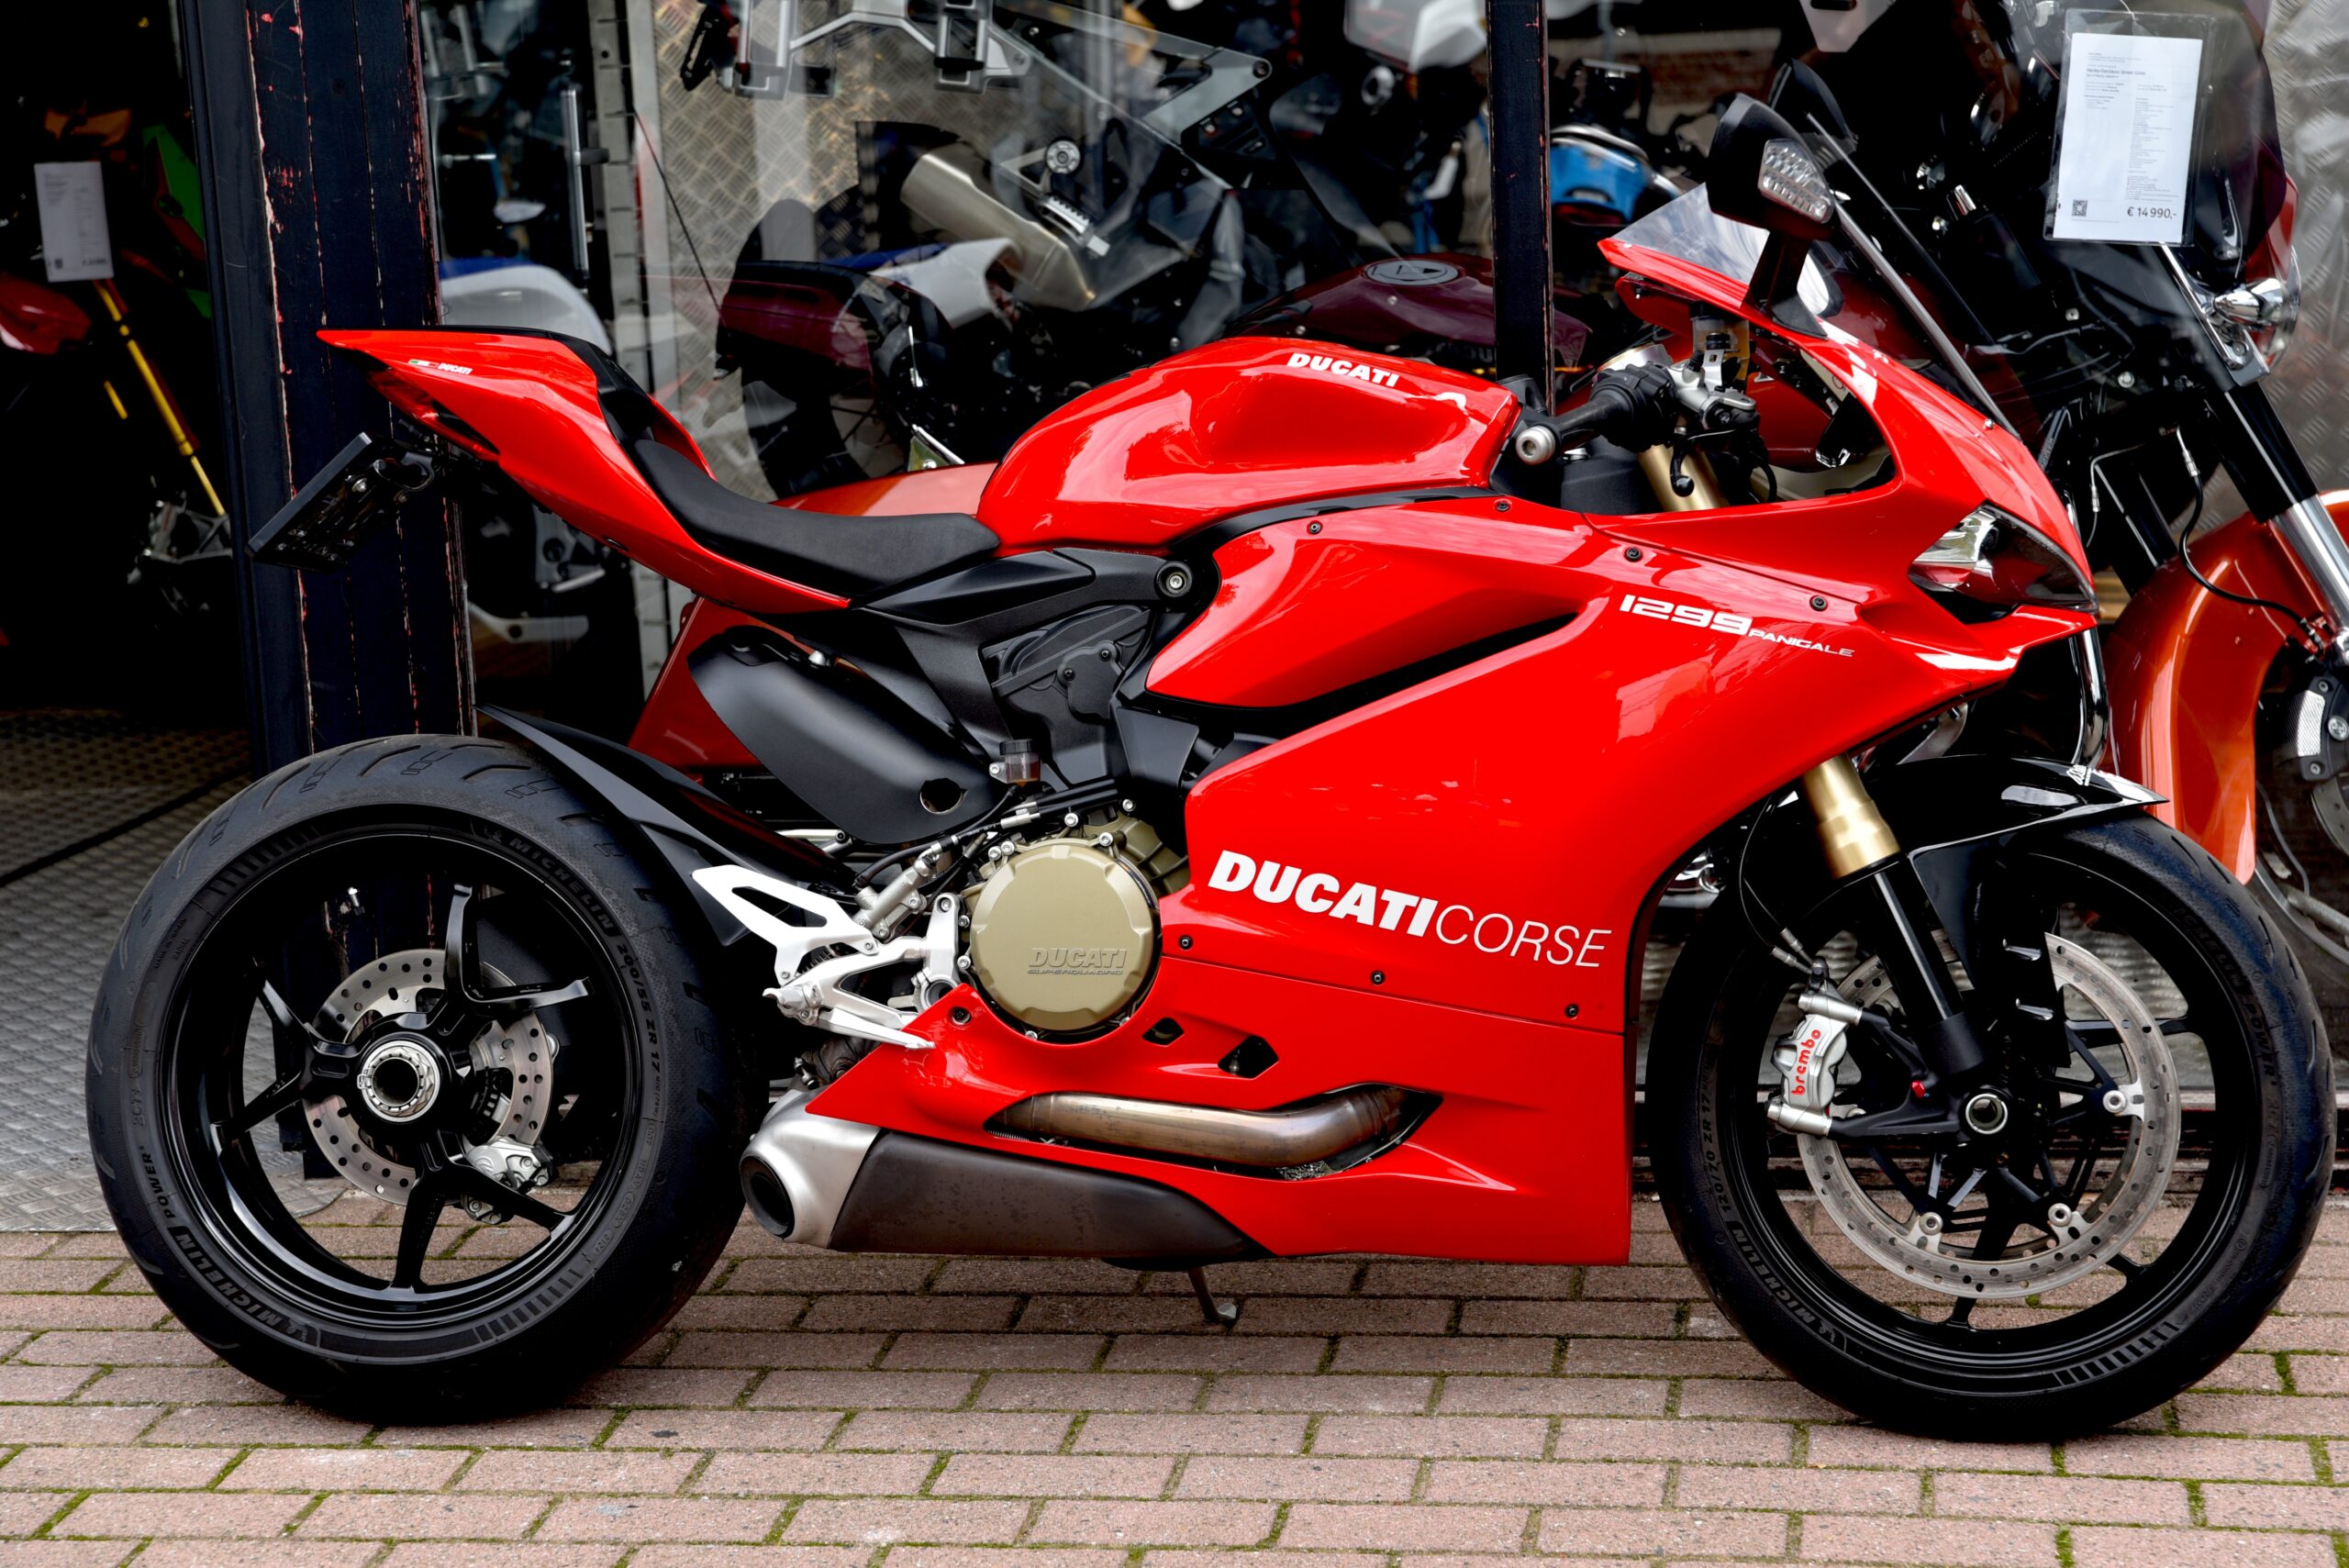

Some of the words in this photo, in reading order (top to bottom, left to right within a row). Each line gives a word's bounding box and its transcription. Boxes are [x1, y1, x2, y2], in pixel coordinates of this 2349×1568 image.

[2127, 206, 2134, 217] €
[438, 362, 473, 374] DUCATI
[1286, 352, 1400, 387] DUCATI
[1619, 595, 1753, 636] 1299
[1748, 628, 1855, 657] PANIGALE
[509, 838, 614, 930] MICHELIN
[1208, 850, 1438, 937] DUCATI
[1436, 905, 1612, 967] CORSE
[1029, 948, 1128, 968] DUCATI
[2162, 897, 2247, 989] ICHELIN
[617, 944, 651, 1012] 200/55
[646, 1018, 658, 1045] ZR
[651, 1051, 661, 1073] 17
[1791, 1029, 1820, 1095] brembo
[1701, 1093, 1710, 1112] 17
[1702, 1120, 1713, 1144] ZR
[1706, 1150, 1731, 1213] 120/70
[174, 1231, 282, 1327] MICHELIN
[1732, 1229, 1816, 1324] MICHELIN
